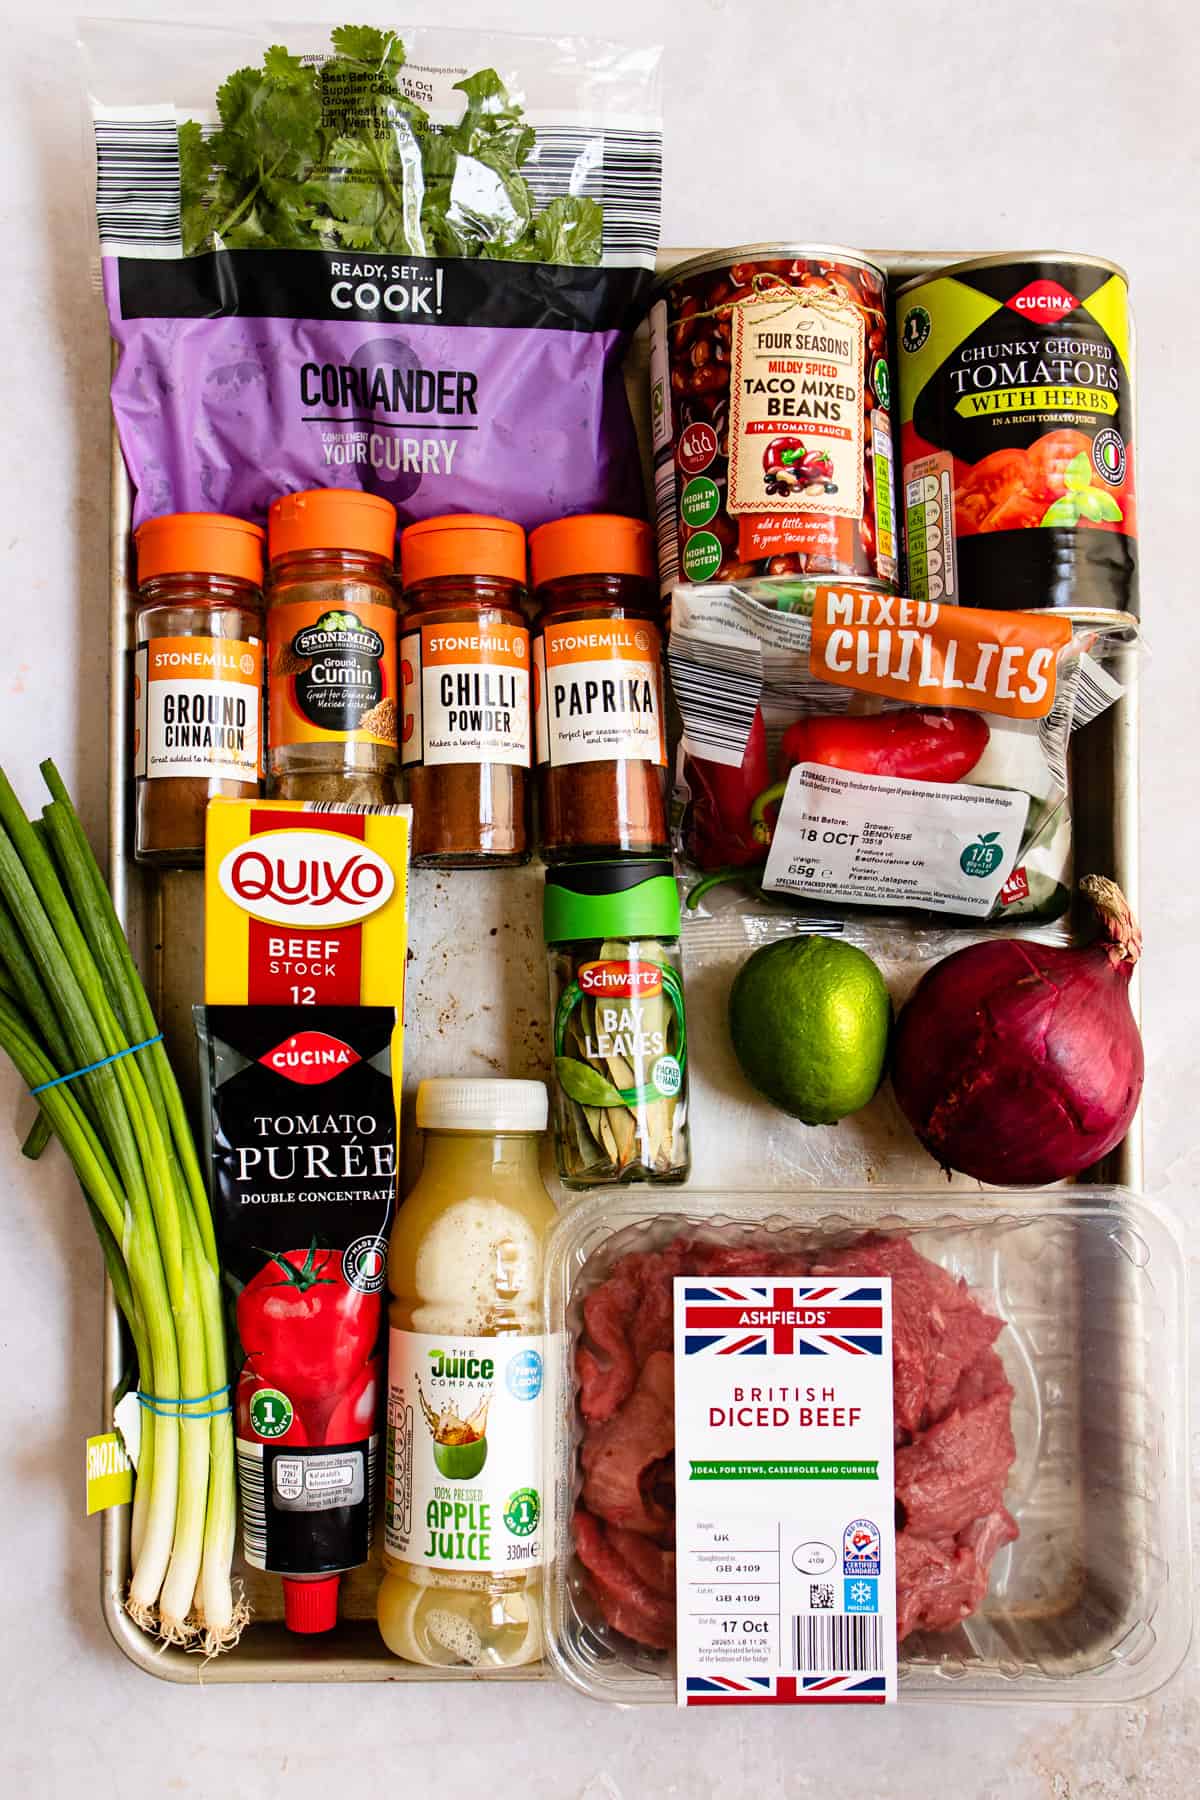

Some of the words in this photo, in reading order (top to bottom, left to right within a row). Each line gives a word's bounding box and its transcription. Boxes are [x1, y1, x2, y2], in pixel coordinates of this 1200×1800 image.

[322, 72, 346, 83] Best
[401, 77, 413, 88] 14
[416, 80, 433, 92] Oct
[322, 84, 367, 96] Supplier
[331, 262, 387, 281] READY,
[391, 265, 433, 281] SET...
[330, 268, 443, 315] COOK!
[1015, 295, 1072, 310] CUCINA
[758, 333, 792, 349] FOUR
[795, 333, 849, 357] SEASONS
[961, 341, 1040, 363] CHUNKY
[1045, 340, 1112, 360] CHOPPED
[768, 360, 803, 374] MILDLY
[805, 363, 838, 378] SPICED
[950, 359, 1119, 394] TOMATOES
[300, 362, 478, 415] CORIANDER
[743, 378, 796, 395] TACO
[801, 380, 856, 402] MIXED
[767, 398, 841, 422] BEANS
[971, 390, 1035, 413] WITH
[1044, 390, 1109, 410] HERBS
[992, 417, 1002, 426] IN
[1011, 415, 1036, 424] RICH
[1037, 414, 1074, 424] TOMATO
[1075, 415, 1097, 425] JUICE
[321, 431, 369, 442] COMPLEMENT
[753, 423, 764, 432] IN
[767, 423, 774, 431] A
[777, 423, 816, 433] TOMATO
[818, 425, 846, 437] SAUCE
[323, 442, 368, 465] YOUR
[369, 433, 458, 475] CURRY
[684, 493, 703, 505] HIGH
[705, 489, 715, 499] IN
[686, 547, 705, 559] HIGH
[707, 543, 717, 553] IN
[685, 554, 719, 569] PROTEIN
[826, 592, 939, 628] MIXED
[301, 631, 378, 651] STONEMILL
[429, 636, 511, 653] STONEMILL
[551, 633, 632, 653] STONEMILL
[155, 652, 237, 669] STONEMILL
[324, 658, 356, 668] Ground
[825, 629, 1054, 703] CHILLIES
[311, 664, 372, 685] Cumin
[329, 689, 339, 700] for
[440, 673, 516, 709] CHILLI
[555, 680, 654, 718] PAPRIKA
[164, 694, 246, 728] GROUND
[448, 710, 511, 733] POWDER
[165, 725, 245, 751] CINNAMON
[429, 738, 451, 748] Makes
[460, 737, 481, 748] lovely
[559, 729, 581, 741] Perfect
[582, 729, 593, 739] for
[821, 815, 848, 826] Before:
[800, 828, 817, 842] 18
[823, 831, 859, 846] OCT
[862, 829, 912, 841] GENOVESE
[788, 864, 815, 878] 65g
[912, 859, 925, 867] UK
[231, 851, 384, 906] QUIXO
[269, 938, 340, 959] BEEF
[269, 961, 336, 976] STOCK
[582, 969, 658, 988] Schwartz
[290, 986, 316, 1005] 12
[603, 1007, 645, 1033] BAY
[585, 1031, 664, 1059] LEAVES
[272, 1050, 349, 1067] CUCINA
[254, 1115, 376, 1136] TOMATO
[235, 1136, 397, 1181] PURÉE
[241, 1192, 295, 1204] DOUBLE
[298, 1189, 396, 1202] CONCENTRATE
[738, 1311, 826, 1325] ASHFIELDS
[452, 1349, 475, 1357] THE
[431, 1379, 493, 1388] COMPANY
[734, 1387, 836, 1402] BRITISH
[263, 1402, 275, 1423] 1
[709, 1407, 790, 1427] DICED
[799, 1407, 862, 1427] BEEF
[694, 1466, 718, 1474] IDEAL
[719, 1466, 736, 1474] FOR
[738, 1466, 766, 1475] STEWS,
[768, 1466, 819, 1474] CASSEROLES
[821, 1466, 839, 1474] AND
[840, 1466, 875, 1474] CURRIES
[434, 1487, 451, 1500] 100%
[454, 1488, 483, 1501] PRESSED
[427, 1500, 491, 1530] APPLE
[520, 1502, 529, 1523] 1
[424, 1530, 491, 1560] JUICE
[714, 1533, 729, 1542] UK
[507, 1542, 530, 1560] 330ml
[716, 1564, 732, 1573] GB
[736, 1564, 760, 1573] 4109
[716, 1594, 732, 1602] GB
[736, 1594, 760, 1602] 4109
[721, 1620, 737, 1633] 17
[743, 1620, 769, 1633] Oct
